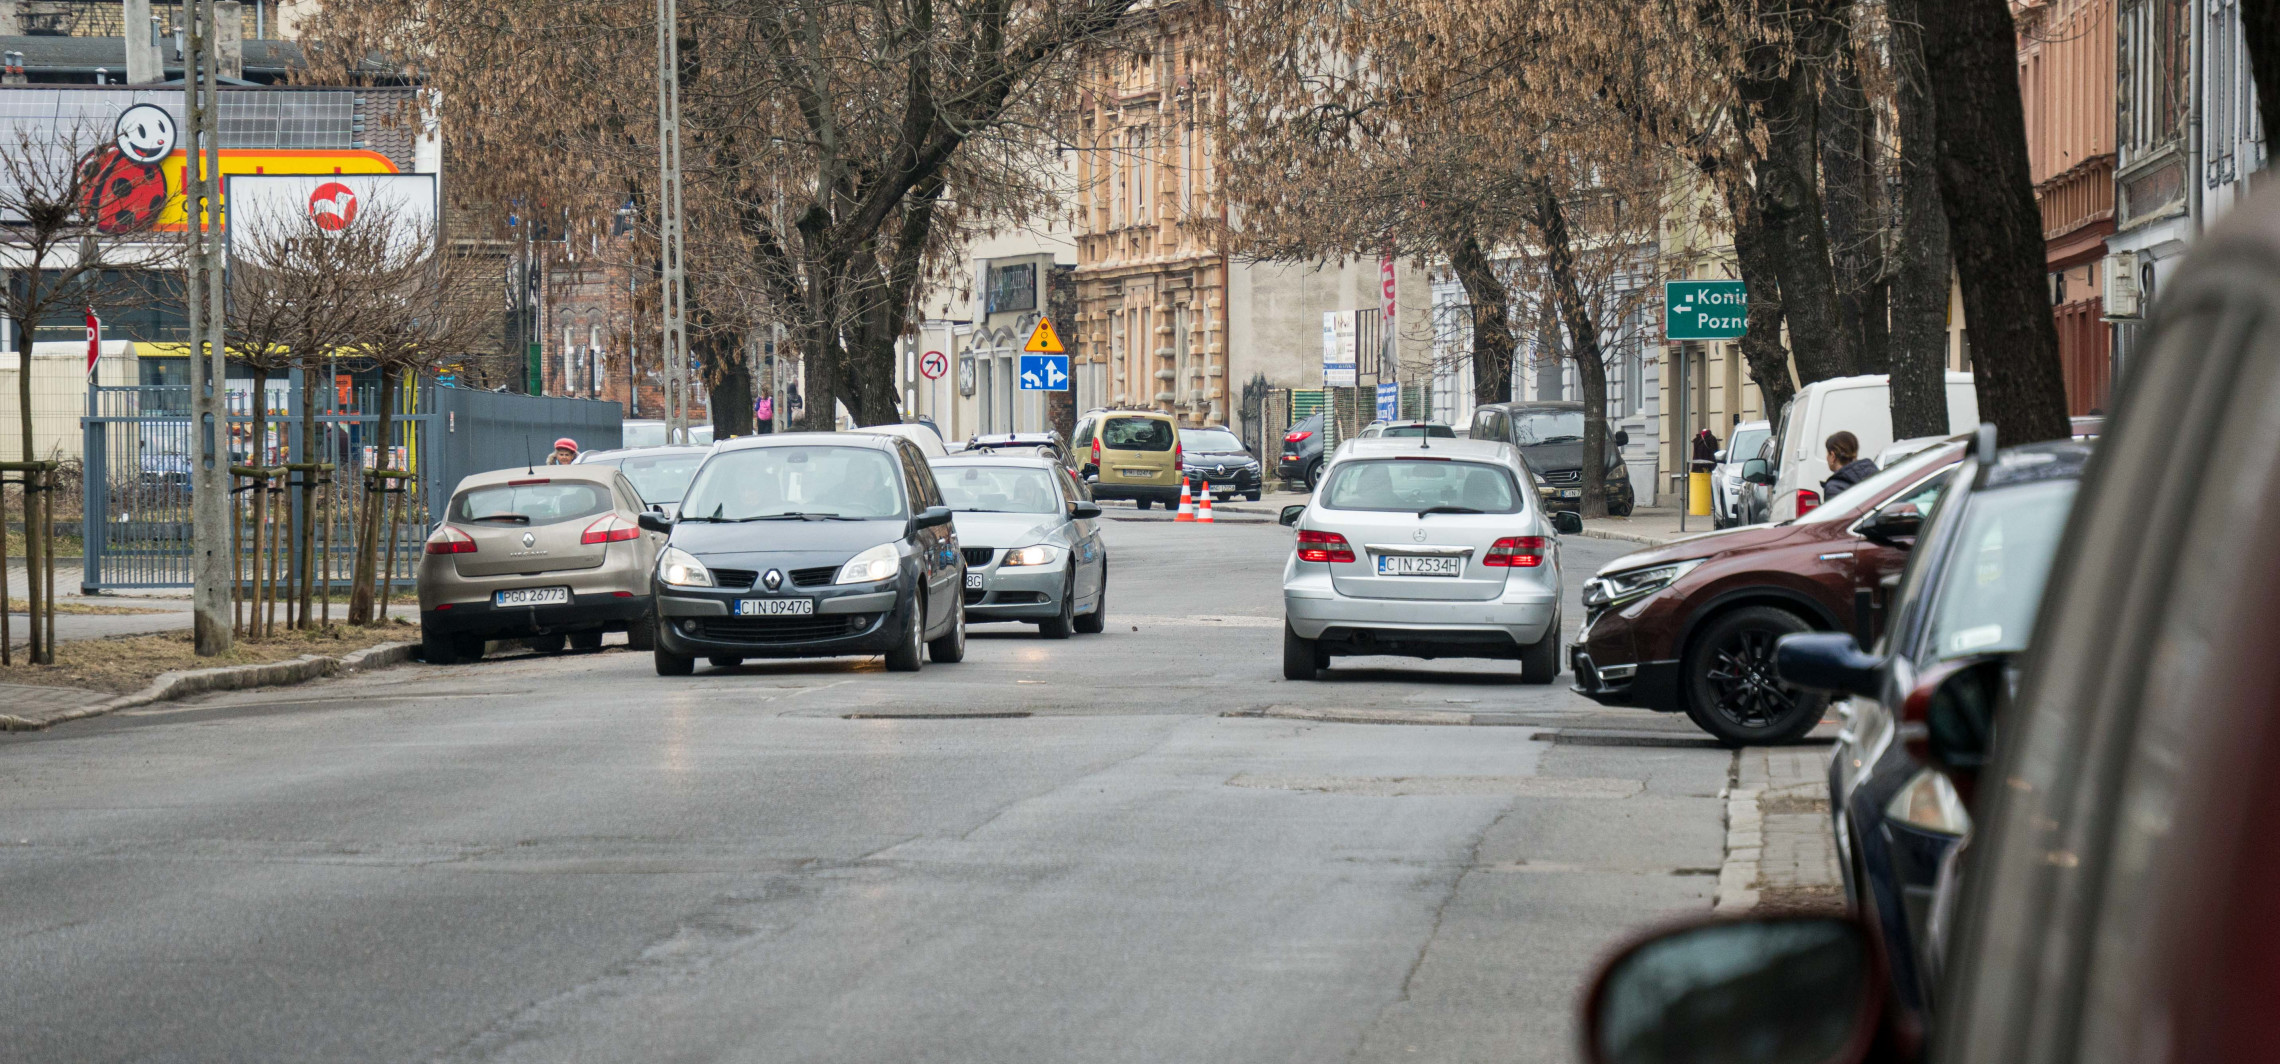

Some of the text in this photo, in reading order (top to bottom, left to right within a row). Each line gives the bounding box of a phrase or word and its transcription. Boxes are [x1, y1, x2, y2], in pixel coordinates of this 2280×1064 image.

[1386, 557, 1412, 572] CIN
[1416, 558, 1458, 573] 2534H
[504, 588, 565, 603] PGO 26773
[741, 601, 767, 614] CIN
[770, 600, 812, 615] 0947G
